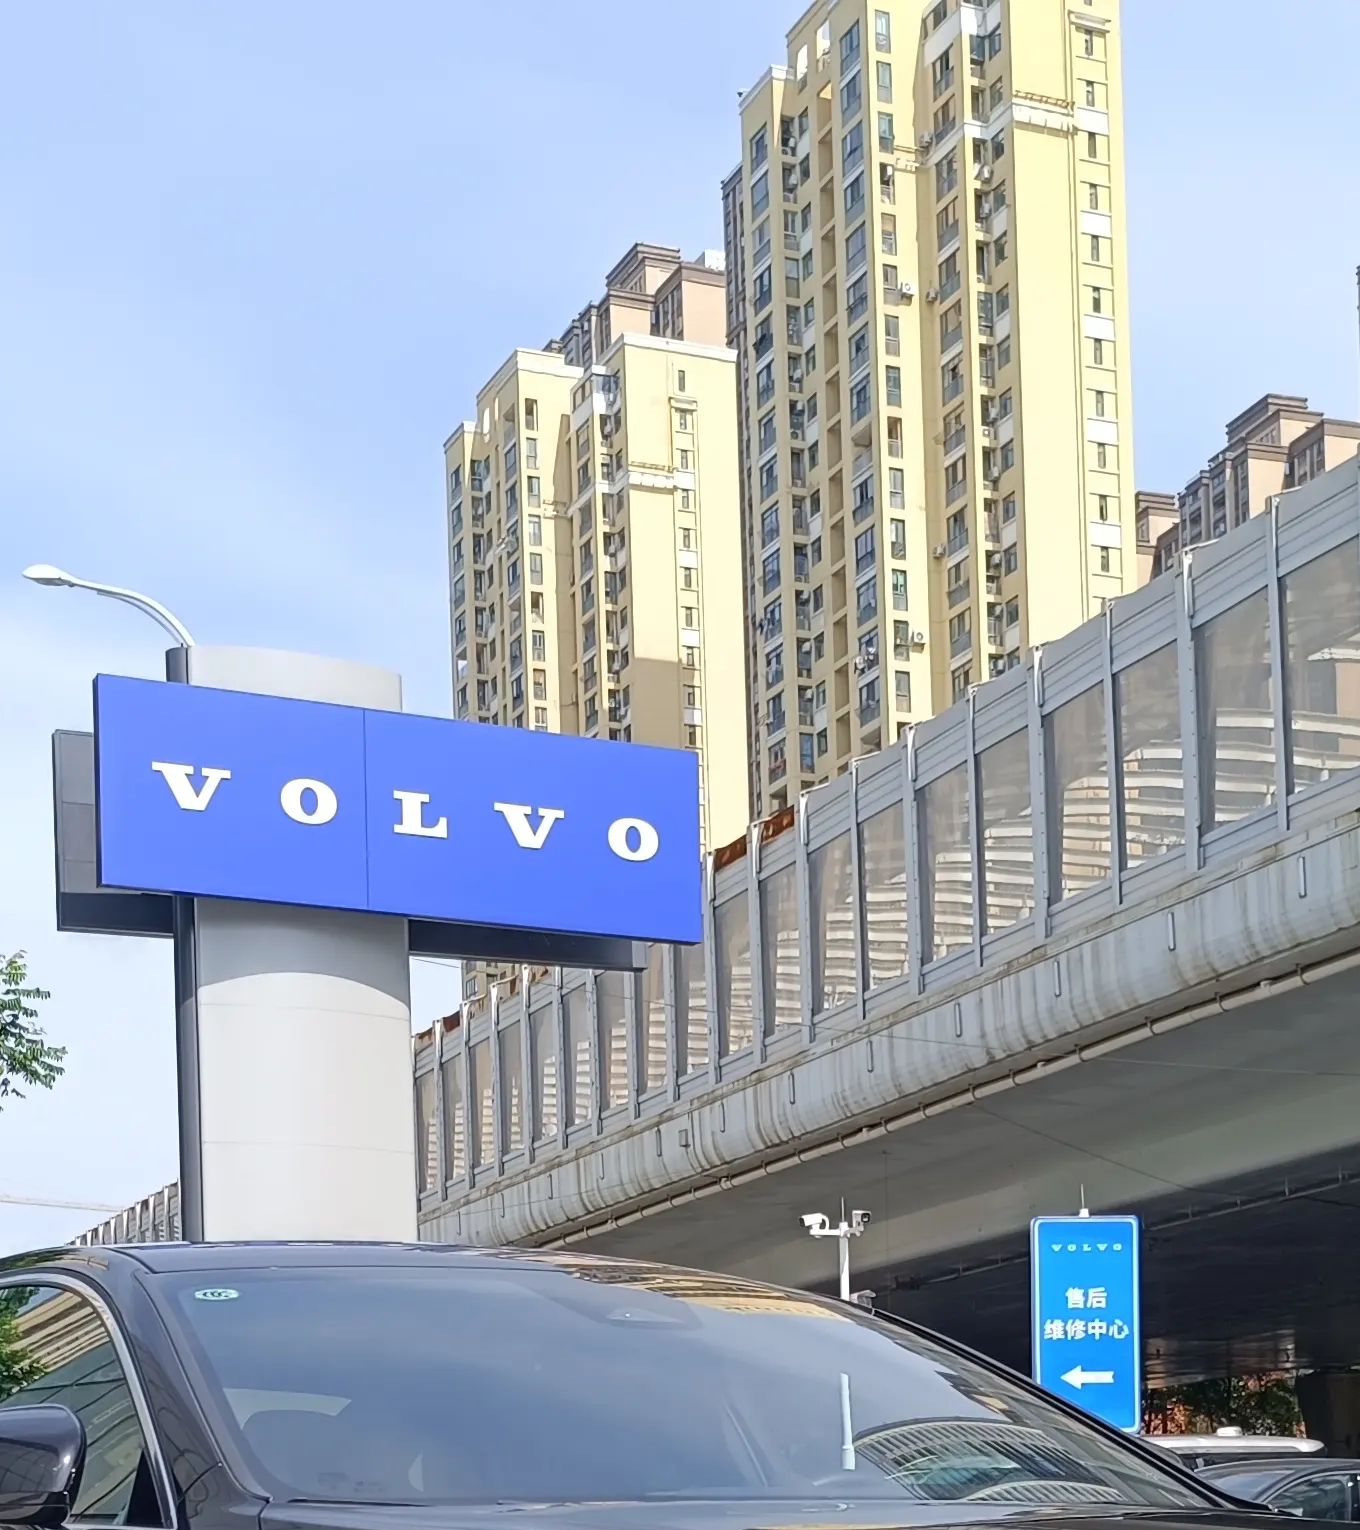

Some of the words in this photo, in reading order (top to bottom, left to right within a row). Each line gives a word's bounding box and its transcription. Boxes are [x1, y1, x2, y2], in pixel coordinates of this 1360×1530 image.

[151, 761, 659, 861] VOLVO
[1065, 1287, 1107, 1309] 售后
[1044, 1318, 1129, 1340] 维修中心
